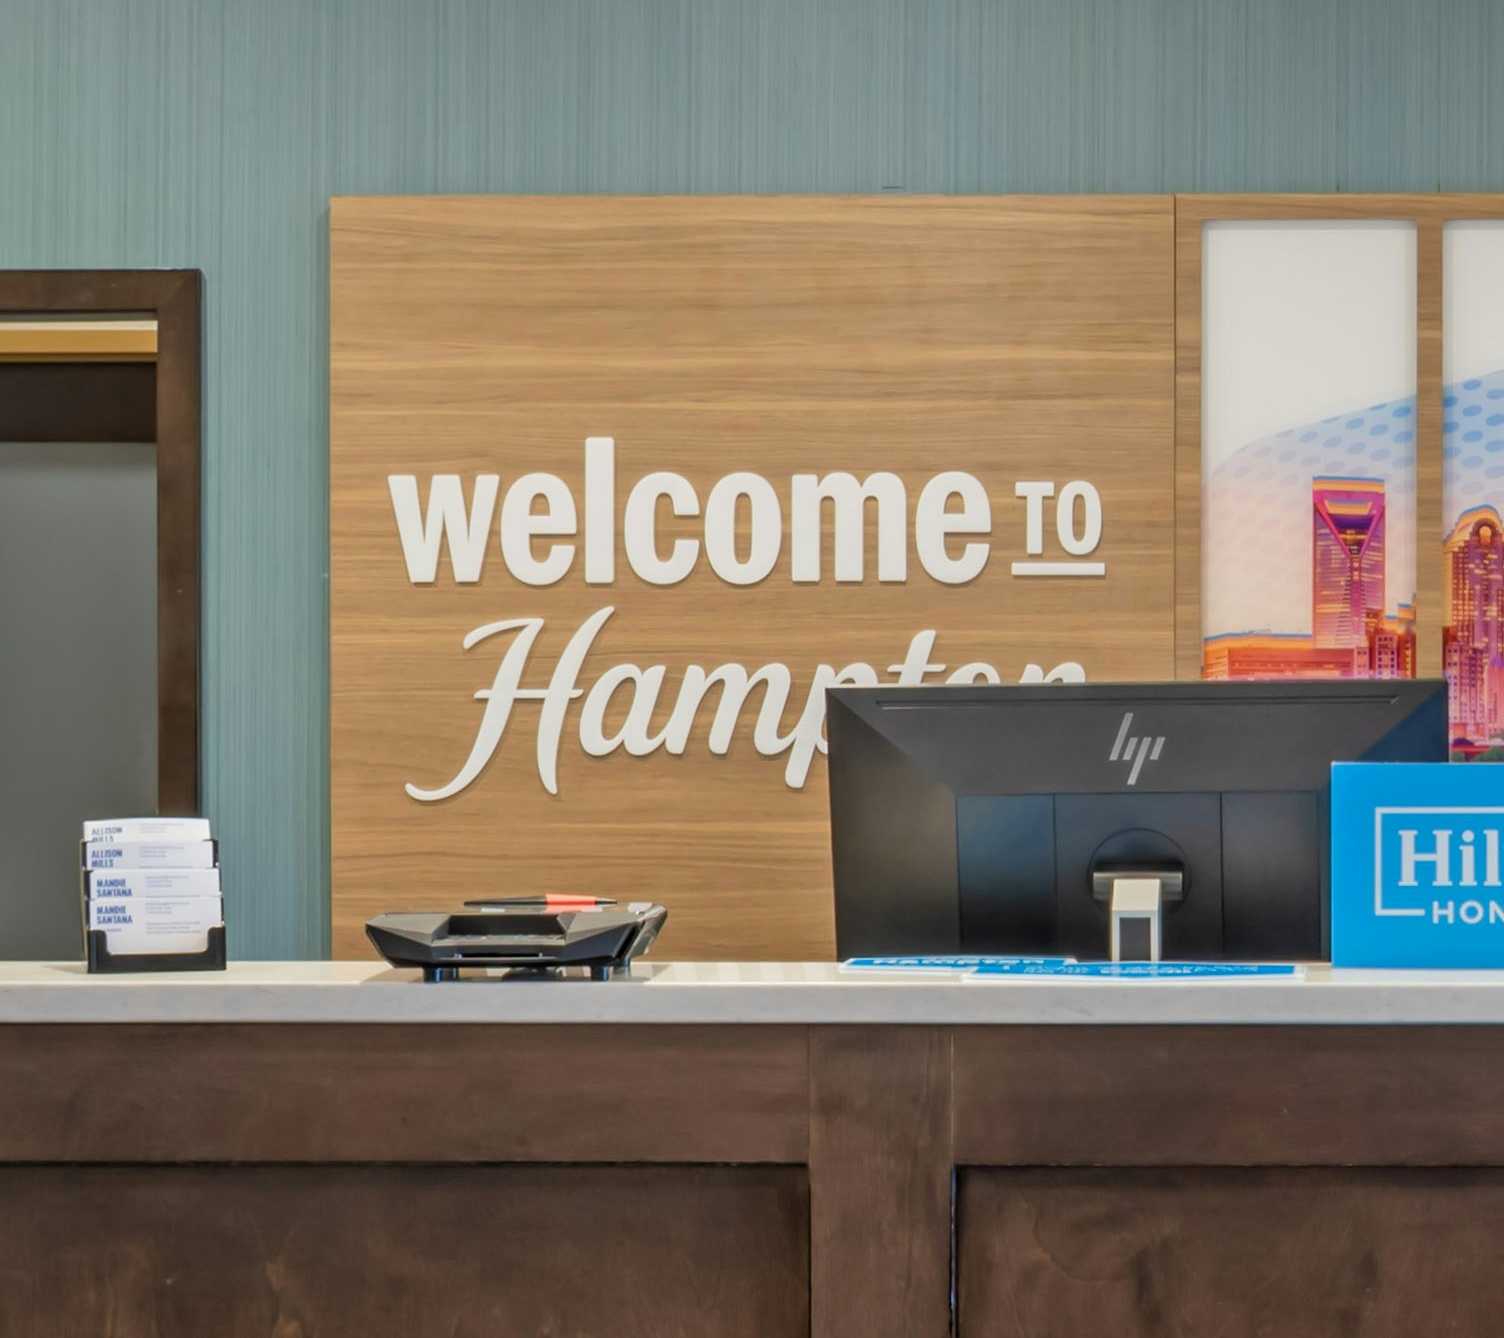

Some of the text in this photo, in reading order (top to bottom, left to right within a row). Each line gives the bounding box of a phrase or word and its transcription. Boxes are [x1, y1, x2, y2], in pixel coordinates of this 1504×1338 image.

[388, 437, 1103, 586] welcome TO
[405, 606, 1087, 804] Hampt
[1108, 712, 1166, 785] hp
[91, 849, 123, 858] ALLISON
